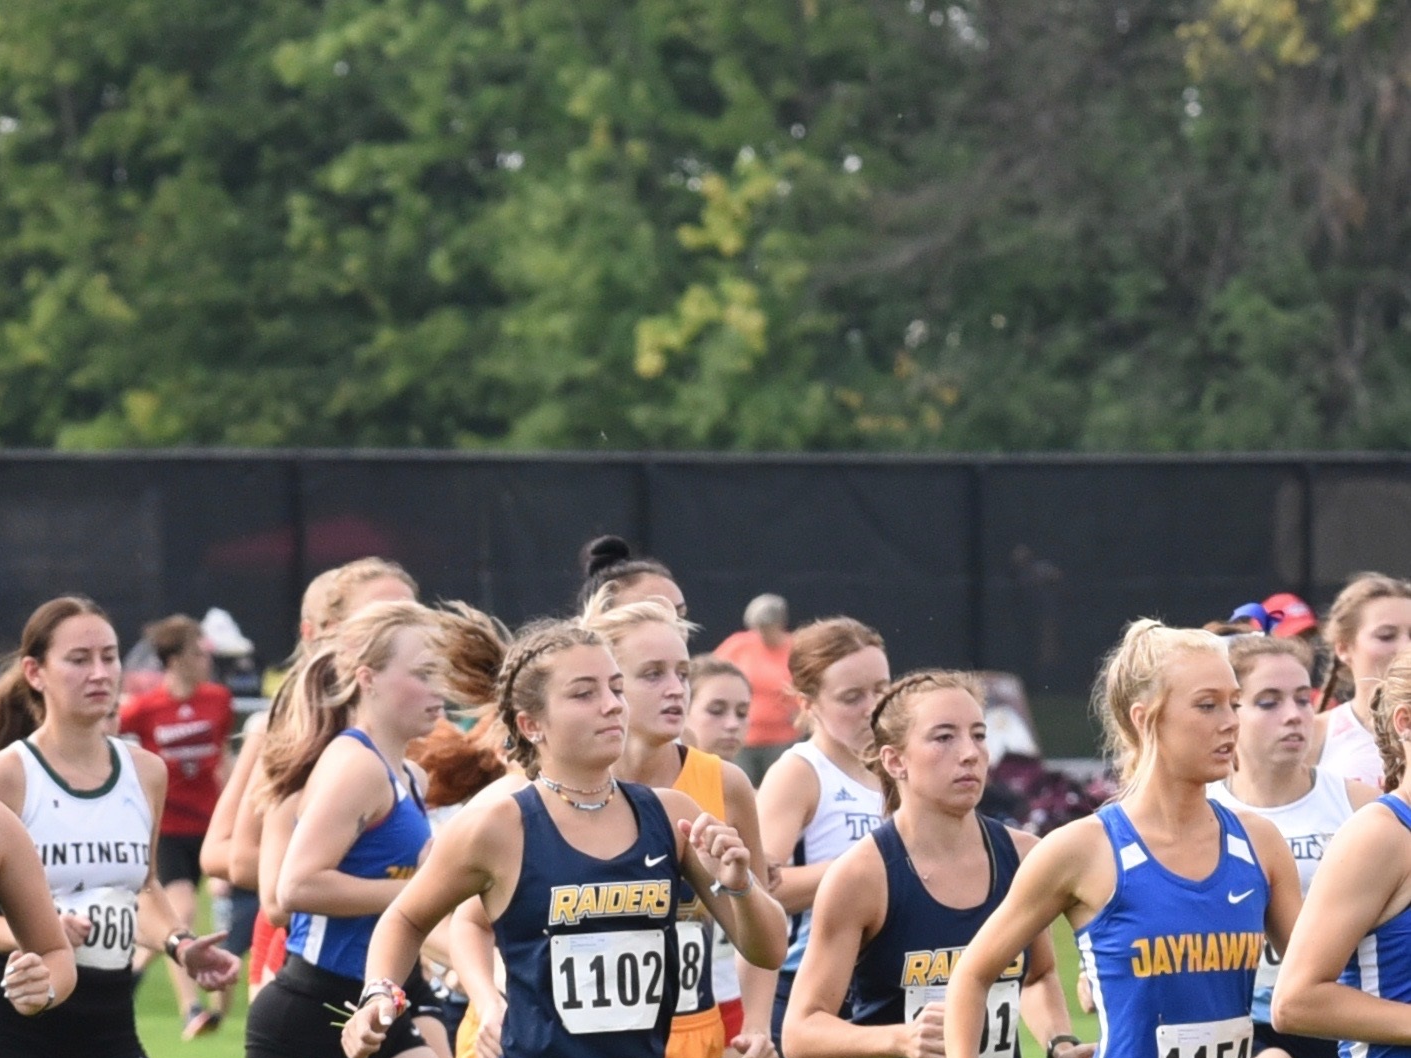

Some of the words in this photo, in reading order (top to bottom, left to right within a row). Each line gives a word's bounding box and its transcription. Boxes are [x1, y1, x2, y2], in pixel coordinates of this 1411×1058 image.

[549, 880, 671, 926] RAIDERS
[1131, 932, 1265, 978] JAYHAWK
[559, 950, 663, 1009] 1102
